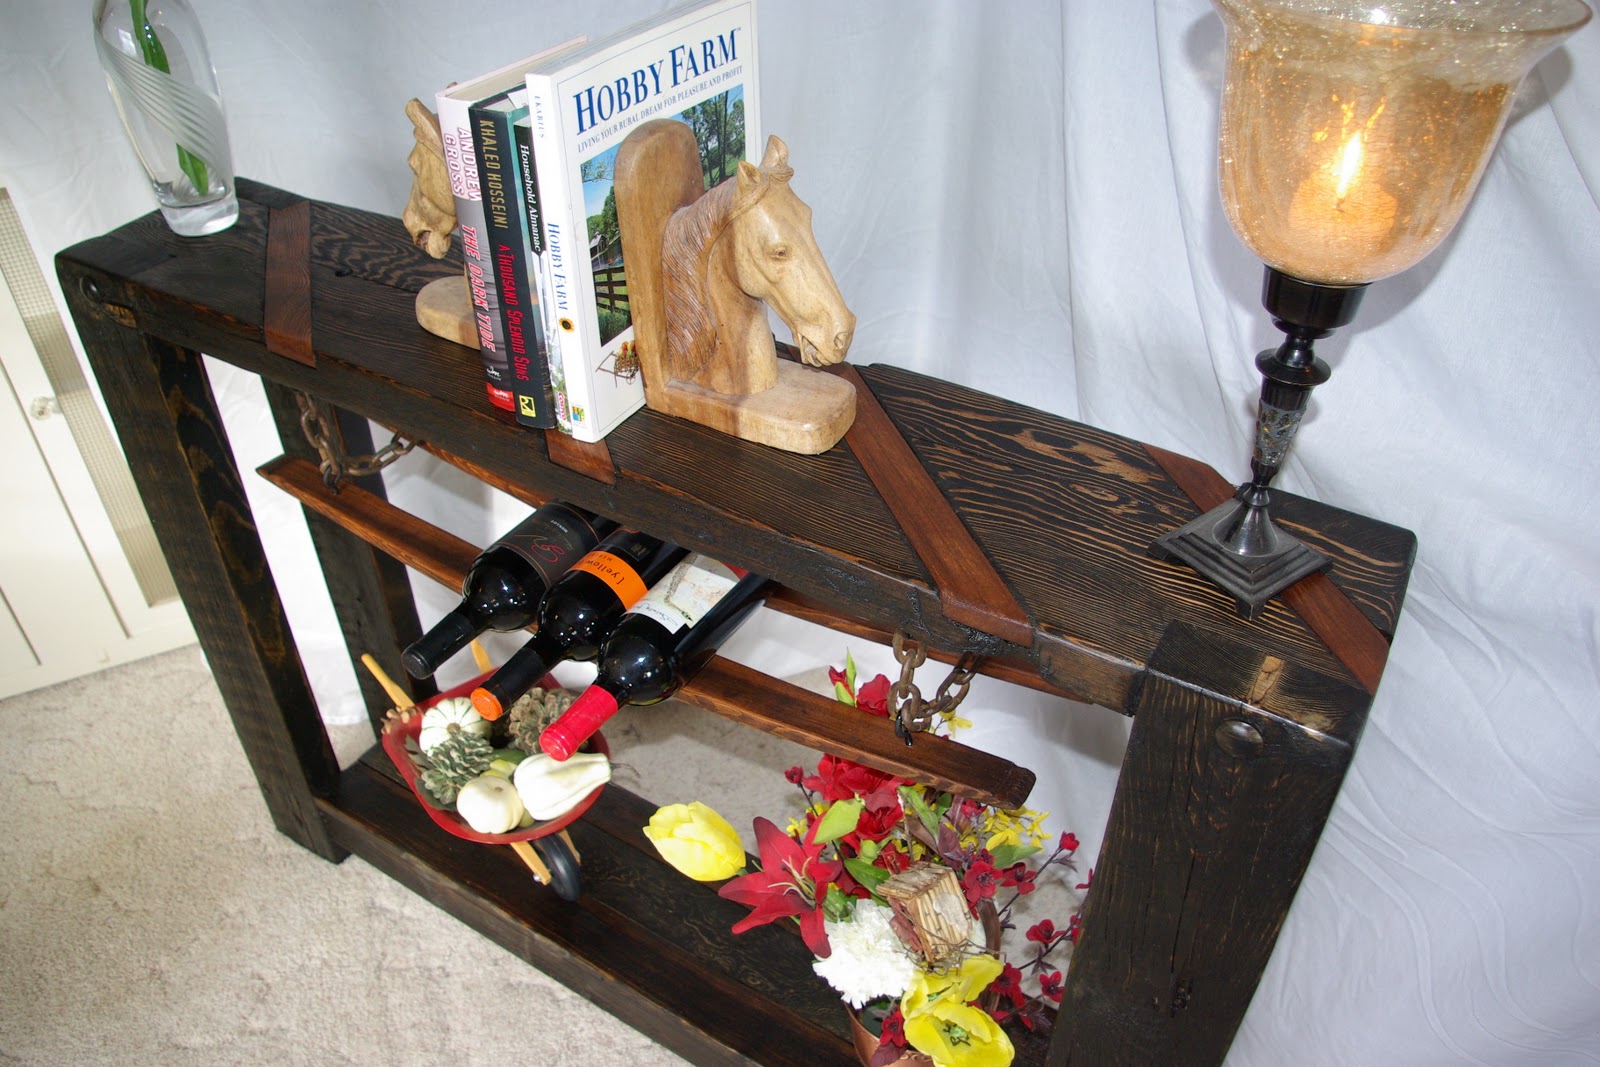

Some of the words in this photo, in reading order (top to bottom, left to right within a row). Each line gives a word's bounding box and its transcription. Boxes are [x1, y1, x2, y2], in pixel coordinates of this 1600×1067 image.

[573, 59, 664, 136] HOBBY
[577, 133, 600, 153] LIVING
[601, 121, 618, 140] YOUR
[619, 112, 639, 129] RURAL
[640, 101, 663, 120] DREAM
[664, 95, 677, 109] FOR
[677, 81, 708, 102] PLEASURE
[708, 75, 721, 88] AND
[722, 66, 743, 81] PROFIT
[444, 134, 465, 196] GROSS
[480, 119, 501, 170] KHALED
[487, 173, 508, 229] HOSSEINI
[520, 144, 536, 204] Household
[528, 205, 541, 252] Almanac
[462, 224, 481, 260] THE
[499, 244, 511, 252] A
[547, 223, 563, 274] HOBBY
[467, 263, 489, 312] DARK
[499, 253, 518, 306] THOUSAND
[554, 274, 568, 311] FARM
[476, 312, 496, 352] TIDE
[507, 309, 525, 358] SPLENDID
[514, 357, 531, 381] SUNS
